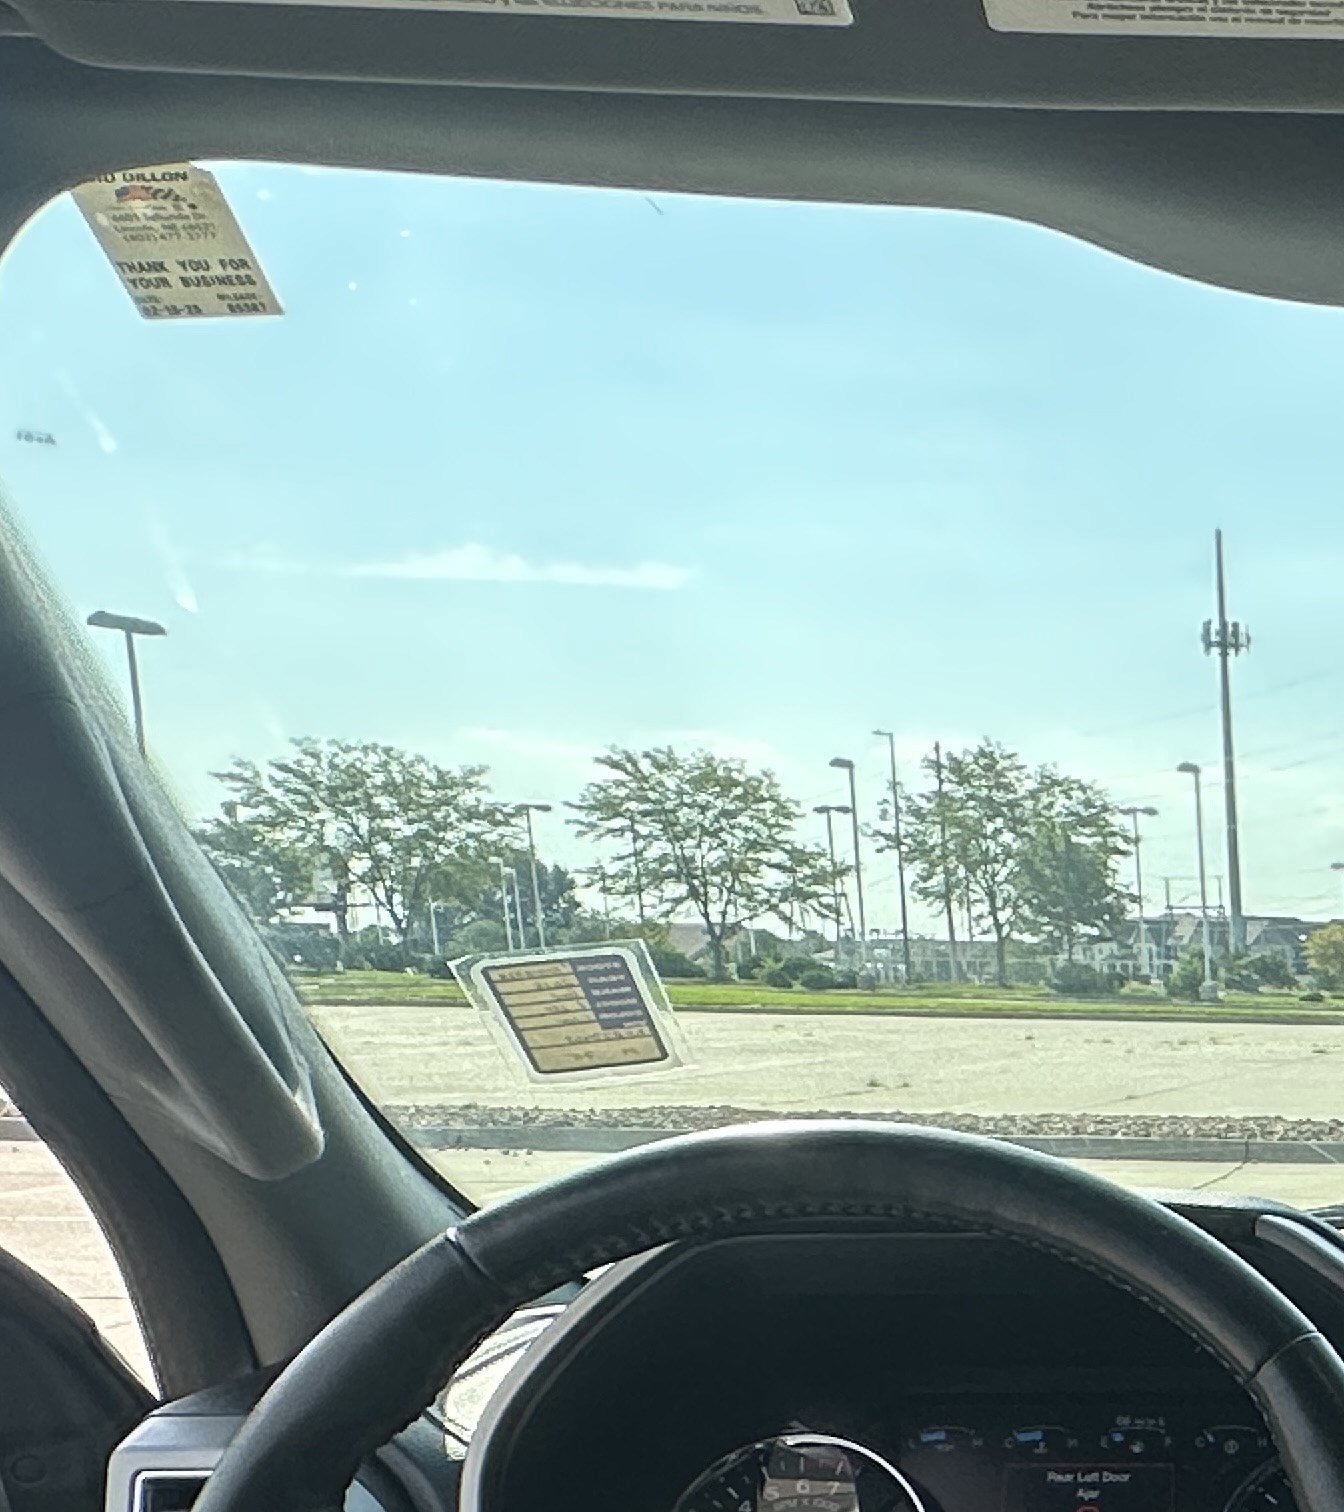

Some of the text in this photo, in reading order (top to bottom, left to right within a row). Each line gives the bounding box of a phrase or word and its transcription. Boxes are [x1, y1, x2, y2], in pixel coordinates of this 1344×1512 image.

[116, 258, 251, 273] THANK YOU FOR
[128, 274, 257, 289] YOUR BUSINESS
[1046, 1470, 1131, 1482] Rear Left Door
[1076, 1488, 1100, 1501] Ajar
